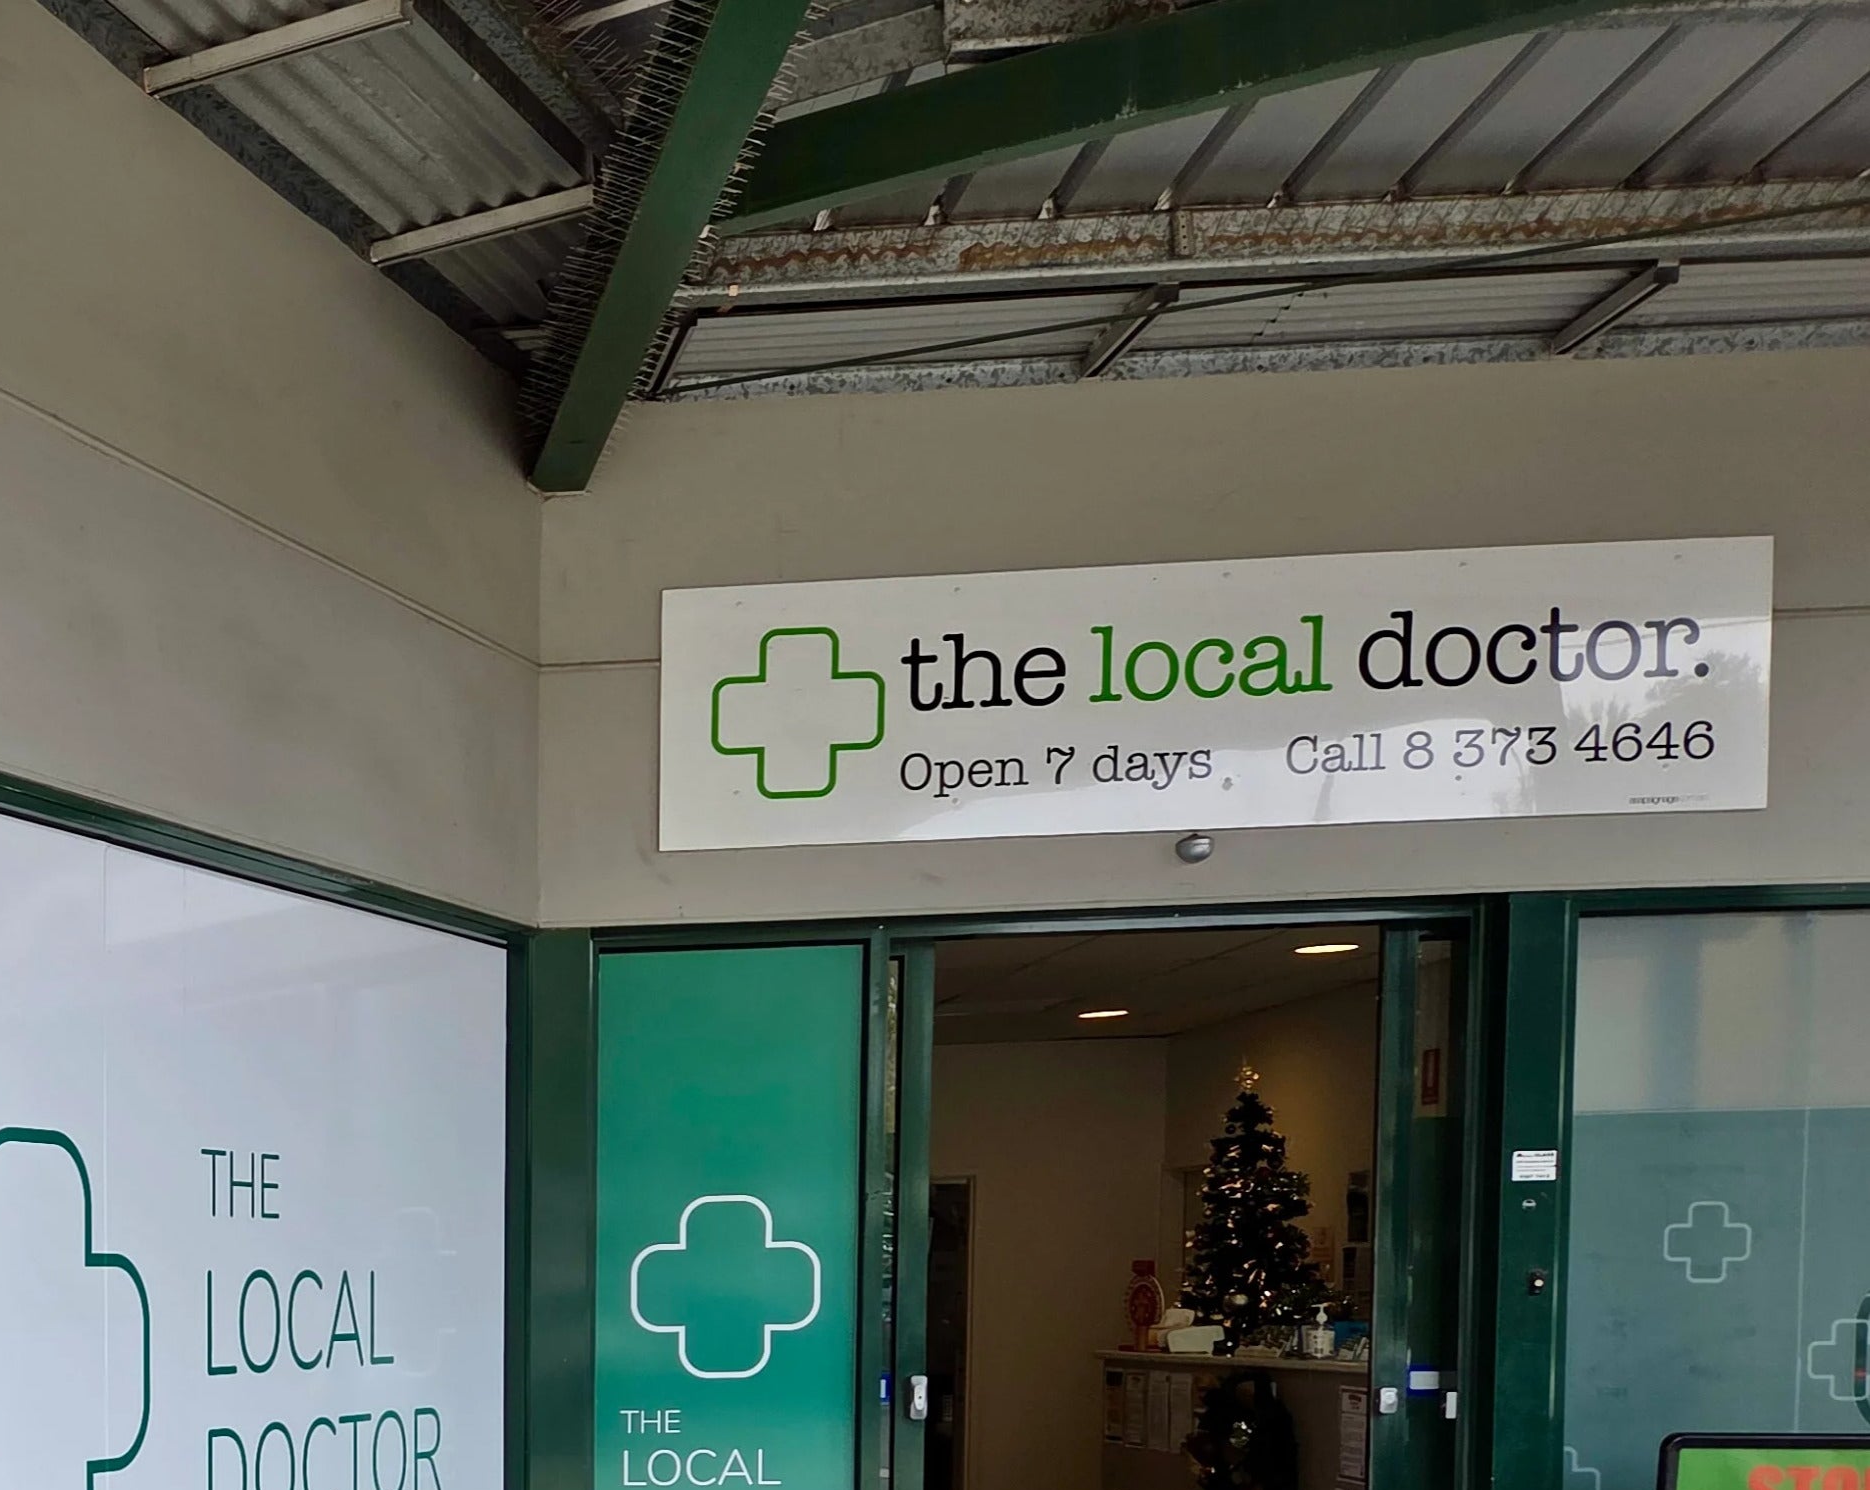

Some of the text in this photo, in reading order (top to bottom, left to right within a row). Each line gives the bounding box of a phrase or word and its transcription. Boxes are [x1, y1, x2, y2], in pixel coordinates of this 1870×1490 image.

[901, 606, 1710, 711] the local doctor.
[900, 720, 1715, 798] Open 7 days Call 8 373 4646
[201, 1148, 280, 1219] THE
[206, 1269, 394, 1376] LOCAL
[619, 1409, 681, 1434] THE
[623, 1448, 781, 1486] LOCAL
